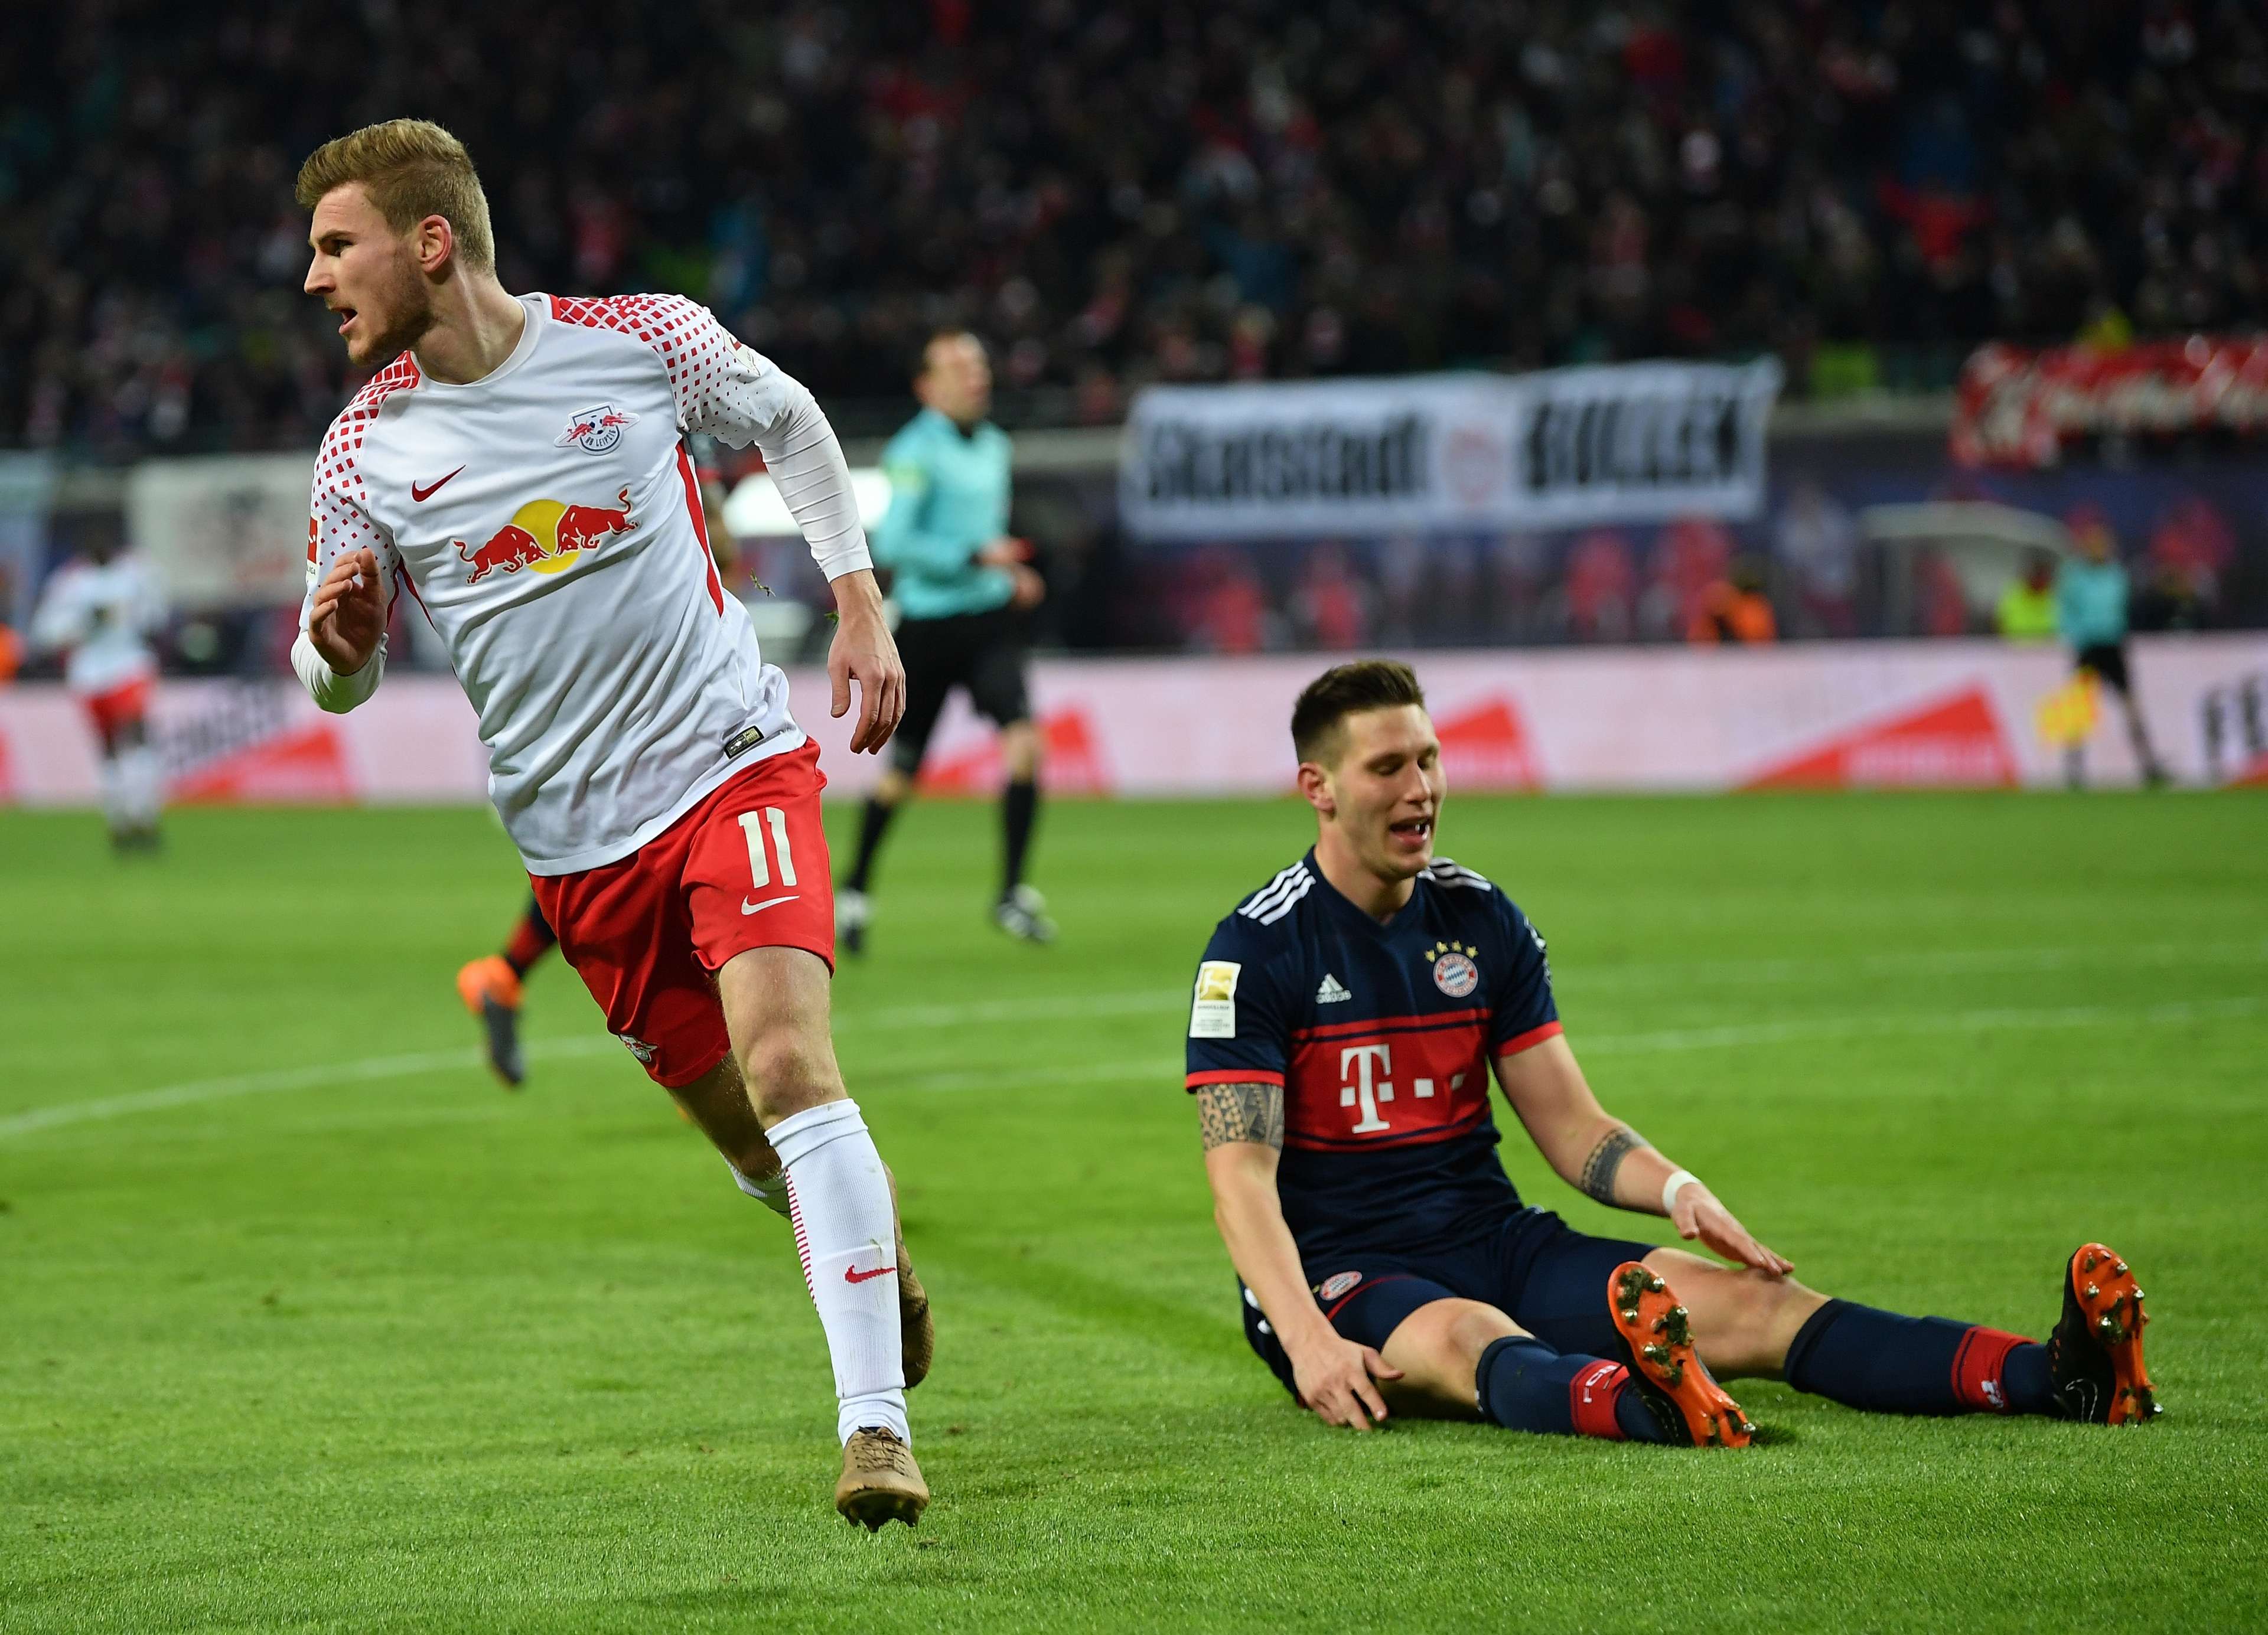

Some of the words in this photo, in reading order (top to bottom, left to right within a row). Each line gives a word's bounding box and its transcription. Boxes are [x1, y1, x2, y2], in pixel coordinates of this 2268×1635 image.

[585, 436, 594, 446] RB
[596, 429, 617, 447] LEIPZIG
[737, 807, 797, 889] 11
